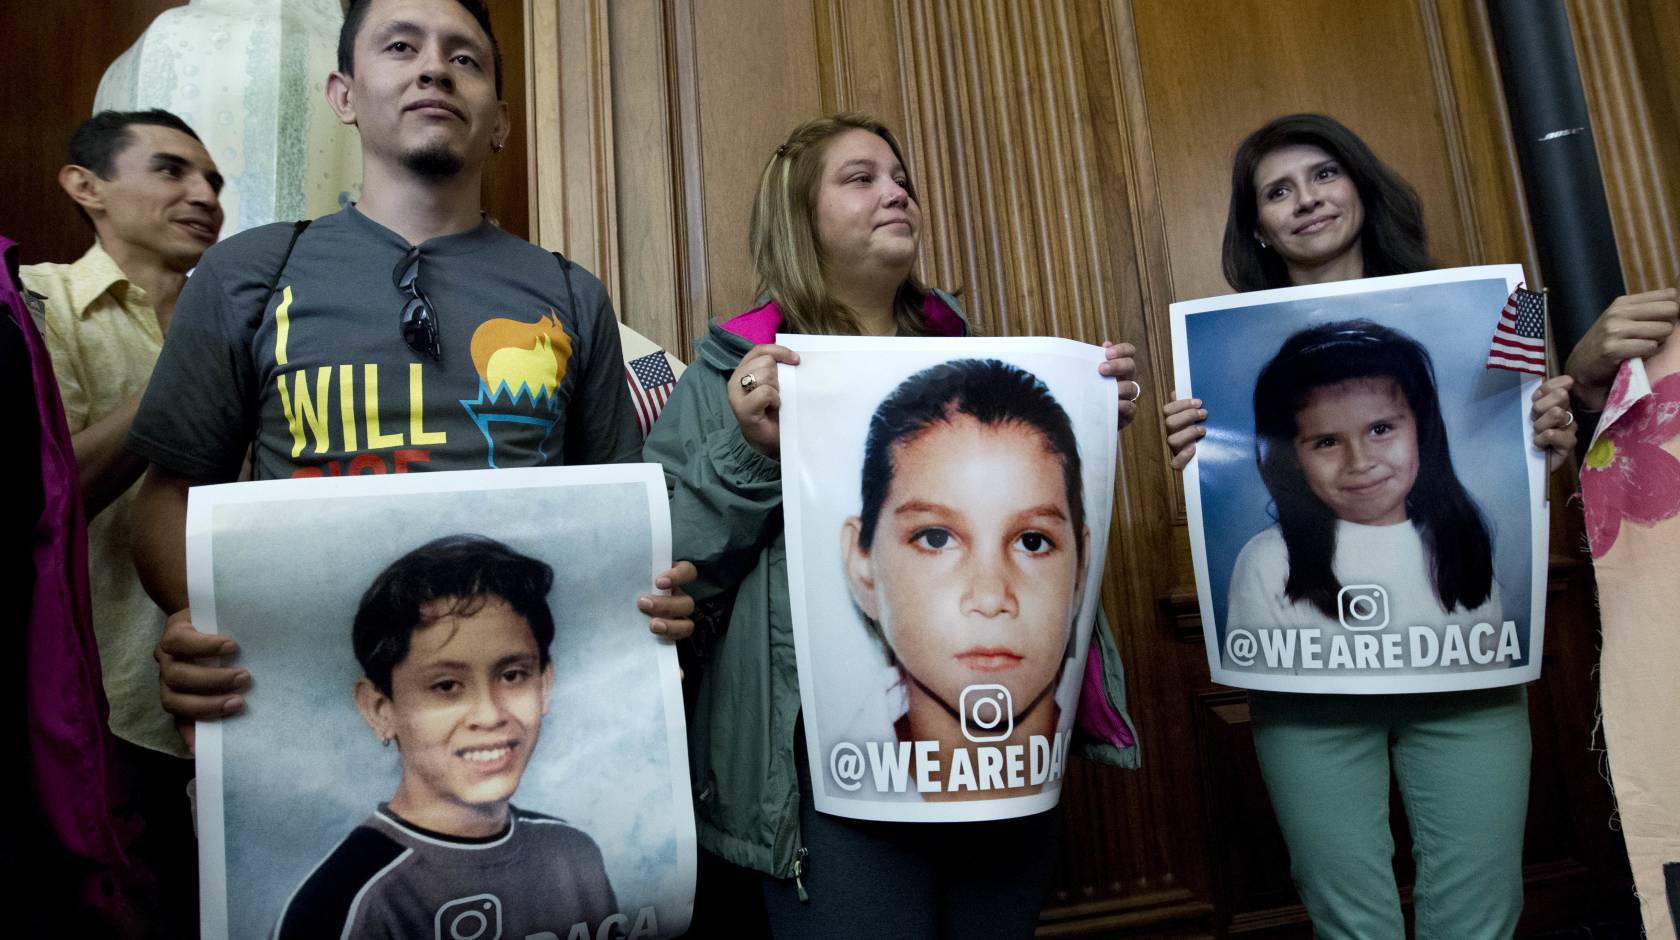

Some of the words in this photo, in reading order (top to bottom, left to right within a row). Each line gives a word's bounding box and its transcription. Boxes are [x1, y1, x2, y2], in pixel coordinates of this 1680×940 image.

[275, 285, 293, 364] I
[276, 363, 447, 458] WILL
[523, 906, 658, 940] ACA
